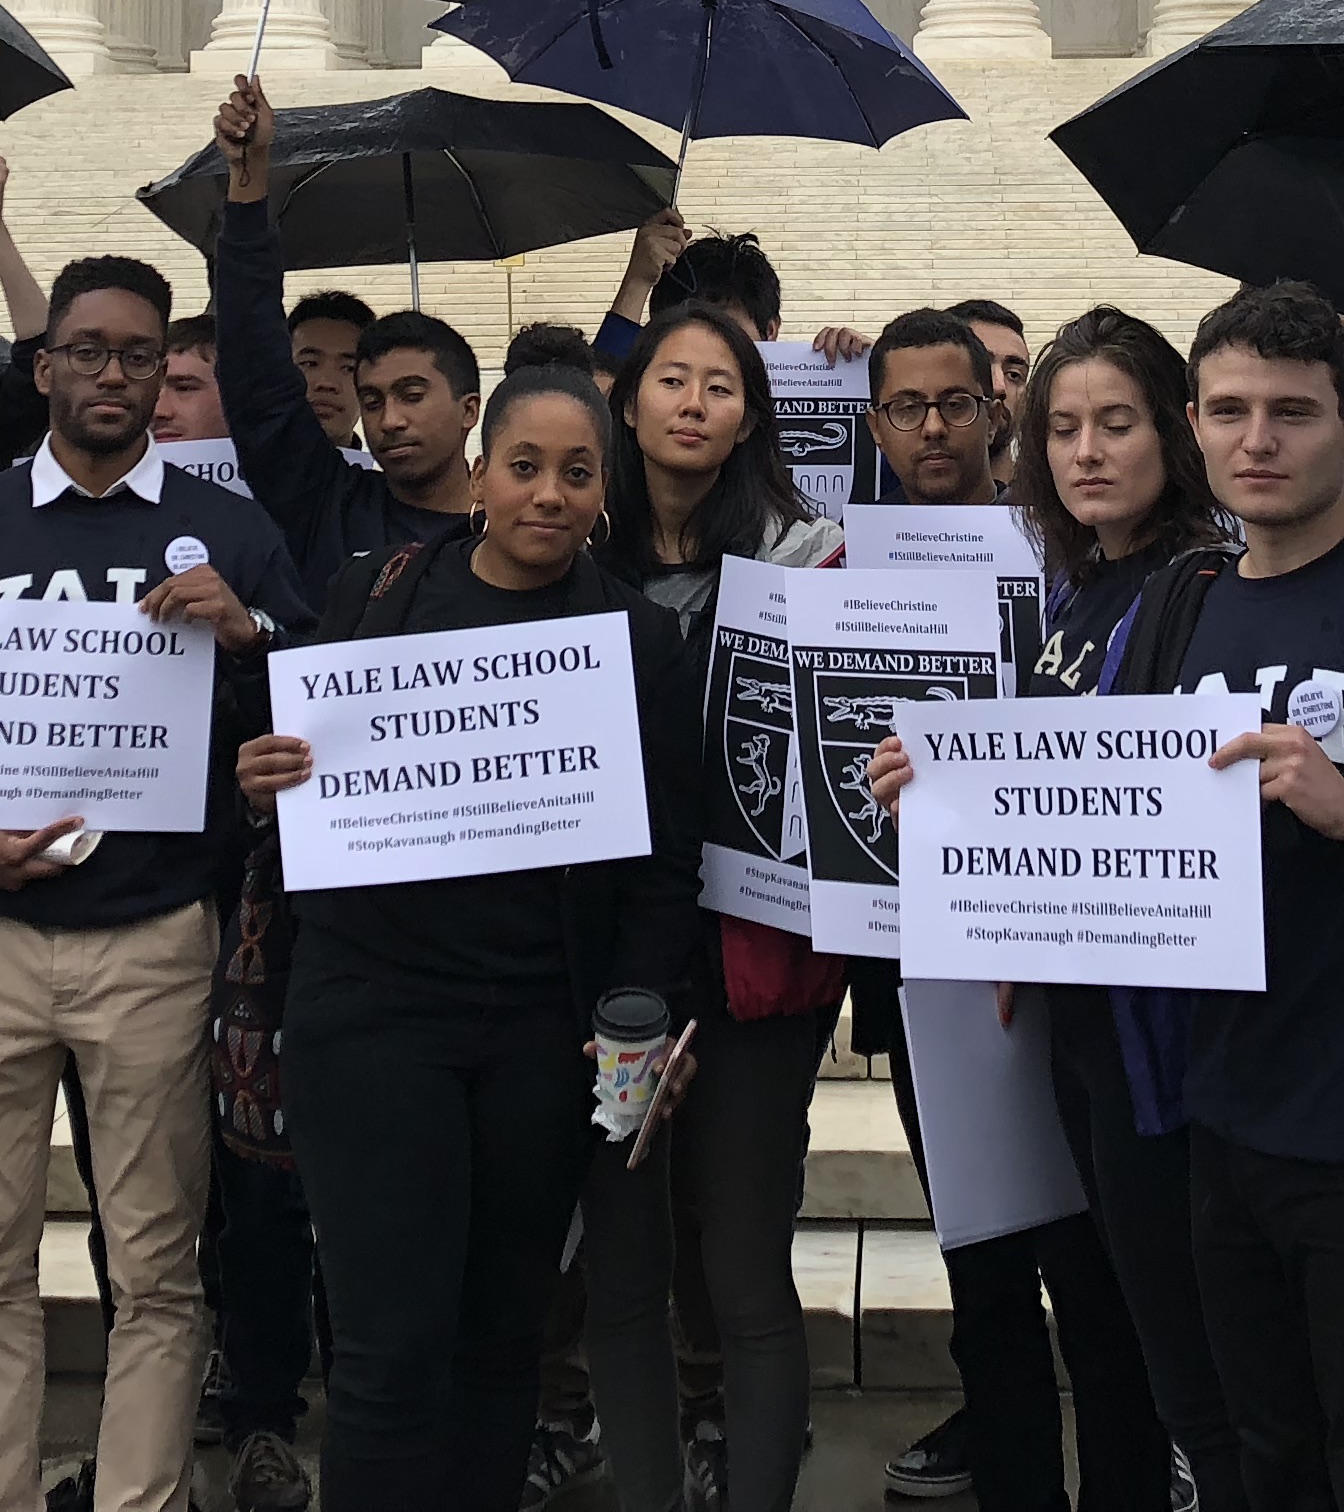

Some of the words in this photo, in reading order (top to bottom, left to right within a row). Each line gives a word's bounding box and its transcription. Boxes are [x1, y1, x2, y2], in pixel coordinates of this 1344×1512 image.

[766, 362, 835, 372] IBelieveChristine
[773, 400, 815, 414] MAND
[895, 532, 984, 543] #IBelieveChristine
[888, 551, 993, 563] #IStillBelieveAnitaHill
[997, 581, 1038, 597] TER
[843, 599, 938, 613] #IBelieveChristine
[834, 621, 948, 635] #IStillBelieveAnitaHill
[63, 629, 185, 657] SCHOOL
[719, 631, 744, 652] WE
[300, 667, 383, 700] YALE
[391, 658, 464, 691] LAW
[473, 644, 601, 683] SCHOOL
[794, 650, 824, 669] WE
[828, 651, 914, 673] DEMAND
[917, 654, 995, 676] BETTER
[369, 699, 540, 742] STUDENTS
[46, 722, 169, 750] BETTER
[924, 731, 1005, 761] YALE
[1014, 731, 1087, 761] LAW
[22, 763, 159, 780] #IStillBelieveAnitaHill
[319, 760, 461, 799] DEMAND
[471, 745, 600, 784] BETTER
[25, 785, 143, 802] #DemandingBetter
[994, 786, 1163, 817] STUDENTS
[329, 807, 449, 831] #IBelieveChristine
[452, 791, 595, 819] #IStillBelieveAnitaHill
[347, 830, 456, 853] #StopKavanaugh
[459, 817, 581, 842] #DemandingBetter
[941, 846, 1082, 878] DEMAND
[1091, 847, 1220, 880] BETTER
[949, 899, 1068, 916] #IBelieveChristine
[1070, 901, 1212, 919] #IStillBelieveAnitaHill
[966, 926, 1074, 944] #StopKavanaugh
[1076, 930, 1197, 949] #DemandingBetter
